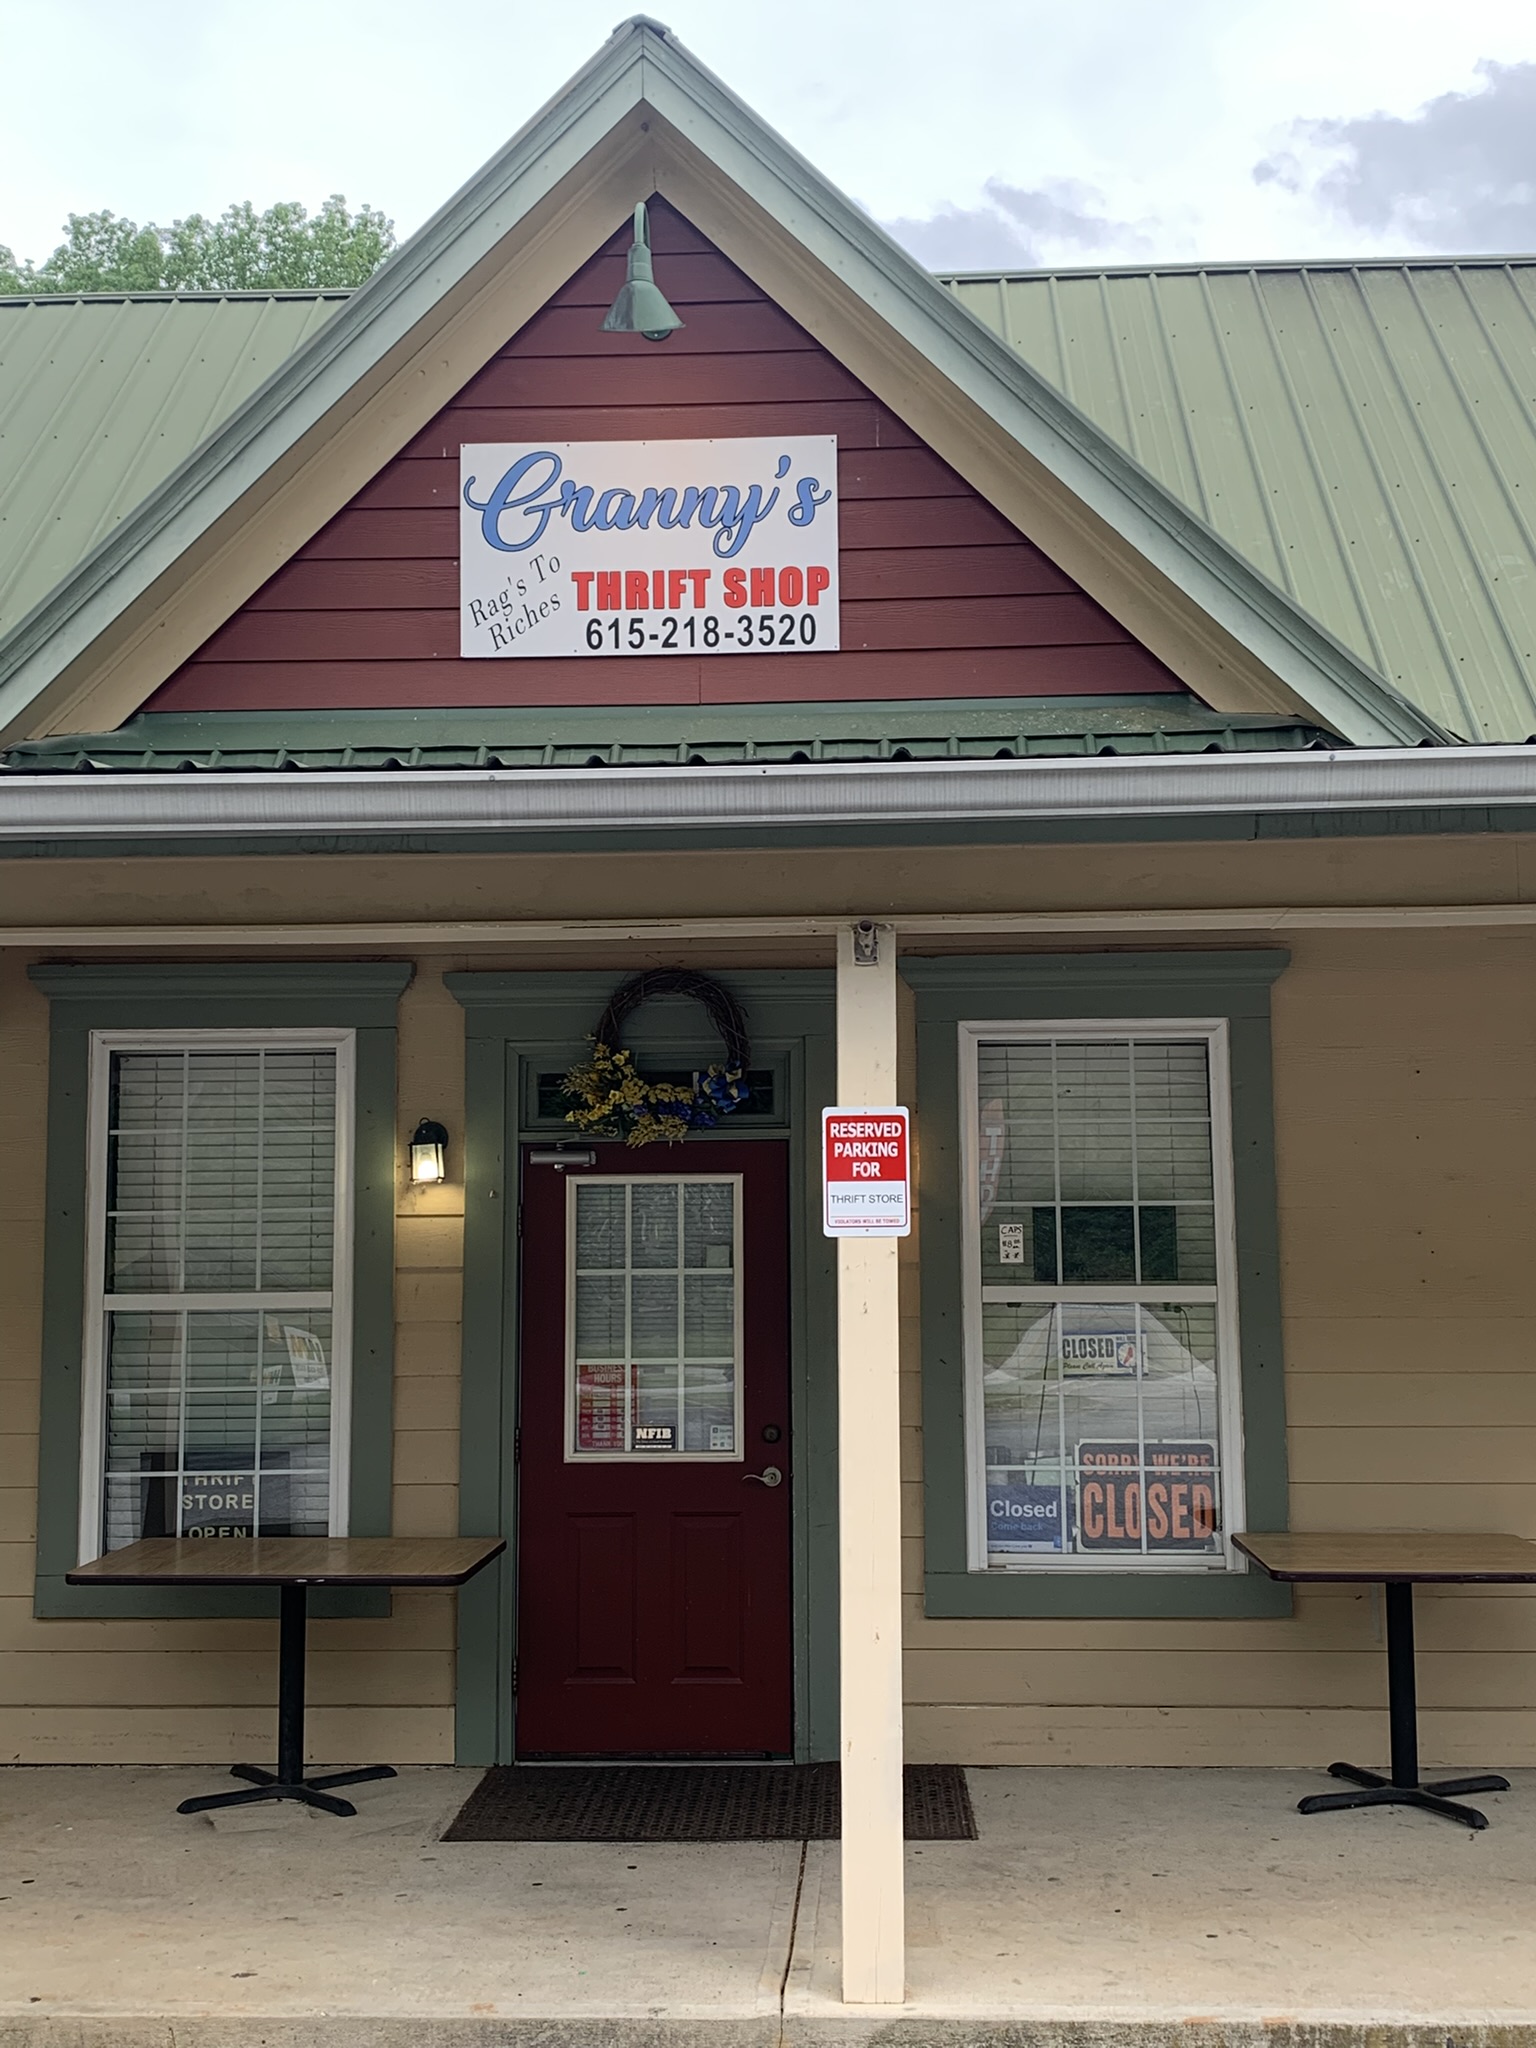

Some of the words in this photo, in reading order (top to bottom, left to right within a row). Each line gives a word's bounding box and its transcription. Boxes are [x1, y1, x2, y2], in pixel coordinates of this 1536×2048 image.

[463, 451, 832, 558] Granny's
[467, 576, 528, 629] Rag's
[529, 554, 561, 584] To
[571, 568, 711, 611] THRIFT
[723, 566, 830, 608] SHOP
[487, 593, 561, 652] Riches
[586, 613, 817, 650] 615-218-3520
[830, 1122, 902, 1138] RESERVED
[834, 1142, 898, 1157] PARKING
[852, 1162, 881, 1177] FOR
[831, 1194, 866, 1204] THRIFT
[868, 1194, 904, 1204] STORE
[1062, 1338, 1115, 1359] CLOSED
[588, 1365, 625, 1373] BUSINES
[593, 1373, 622, 1383] HOURS
[636, 1428, 672, 1439] NFIB
[1152, 1454, 1212, 1476] WE'RE
[183, 1494, 253, 1510] STORE
[990, 1500, 1057, 1517] Closed
[1083, 1482, 1213, 1538] CLOSED
[188, 1526, 247, 1538] OPEN
